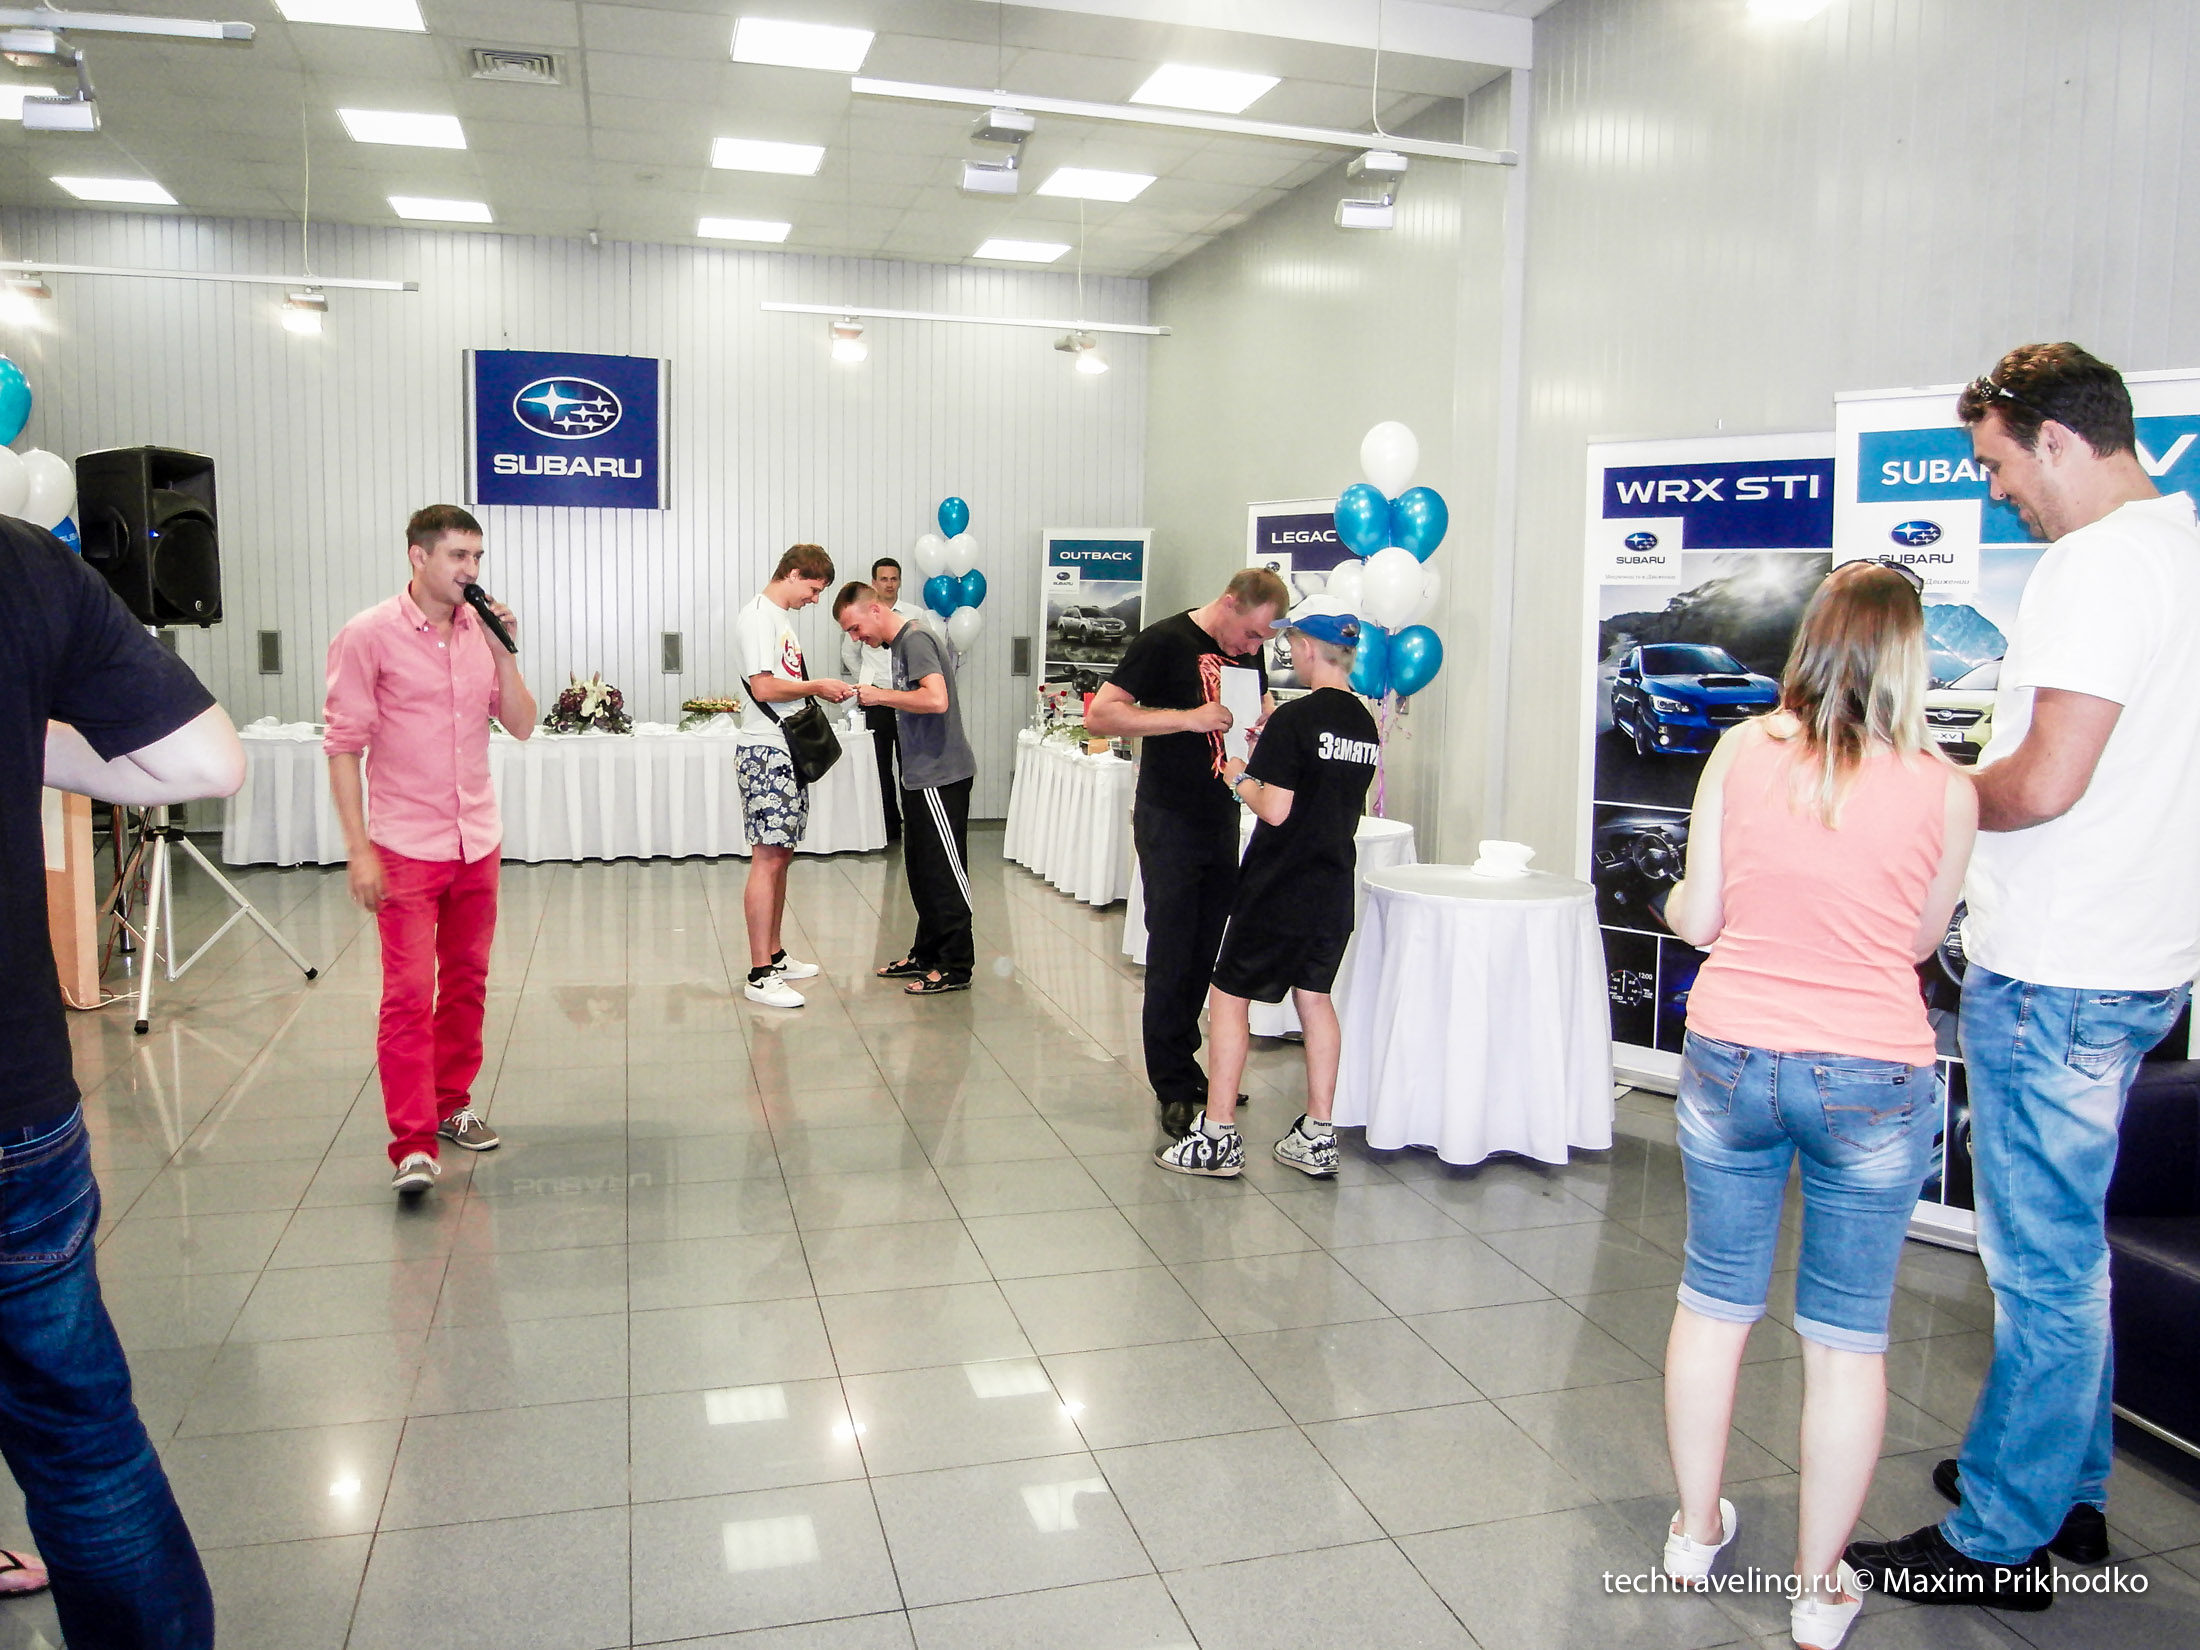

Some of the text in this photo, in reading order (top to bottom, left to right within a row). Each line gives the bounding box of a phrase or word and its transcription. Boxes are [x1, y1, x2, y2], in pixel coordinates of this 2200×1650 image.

[494, 454, 642, 479] SUBARU
[1616, 475, 1819, 504] WRX STI
[1271, 530, 1337, 544] LEGAC
[1059, 551, 1133, 561] OUTBACK
[1616, 556, 1666, 565] SUBARU
[1878, 553, 1954, 564] SUBARU
